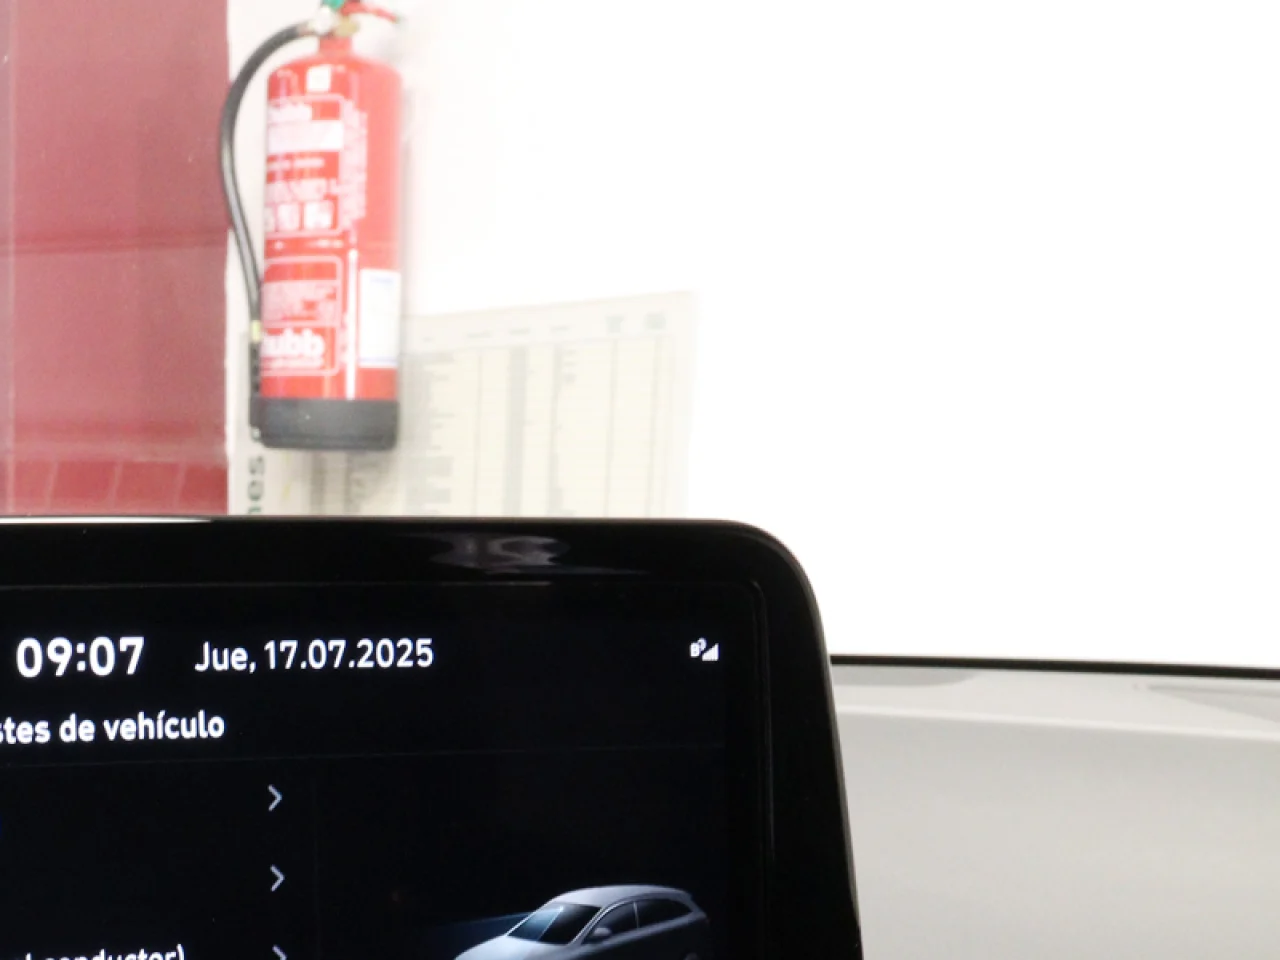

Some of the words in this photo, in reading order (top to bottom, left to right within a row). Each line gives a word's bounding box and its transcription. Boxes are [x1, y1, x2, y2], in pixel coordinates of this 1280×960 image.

[15, 637, 145, 678] 09:07
[194, 641, 257, 673] Jue,
[263, 637, 436, 671] 17.07.2025
[58, 712, 96, 744] de
[103, 709, 226, 743] vehículo
